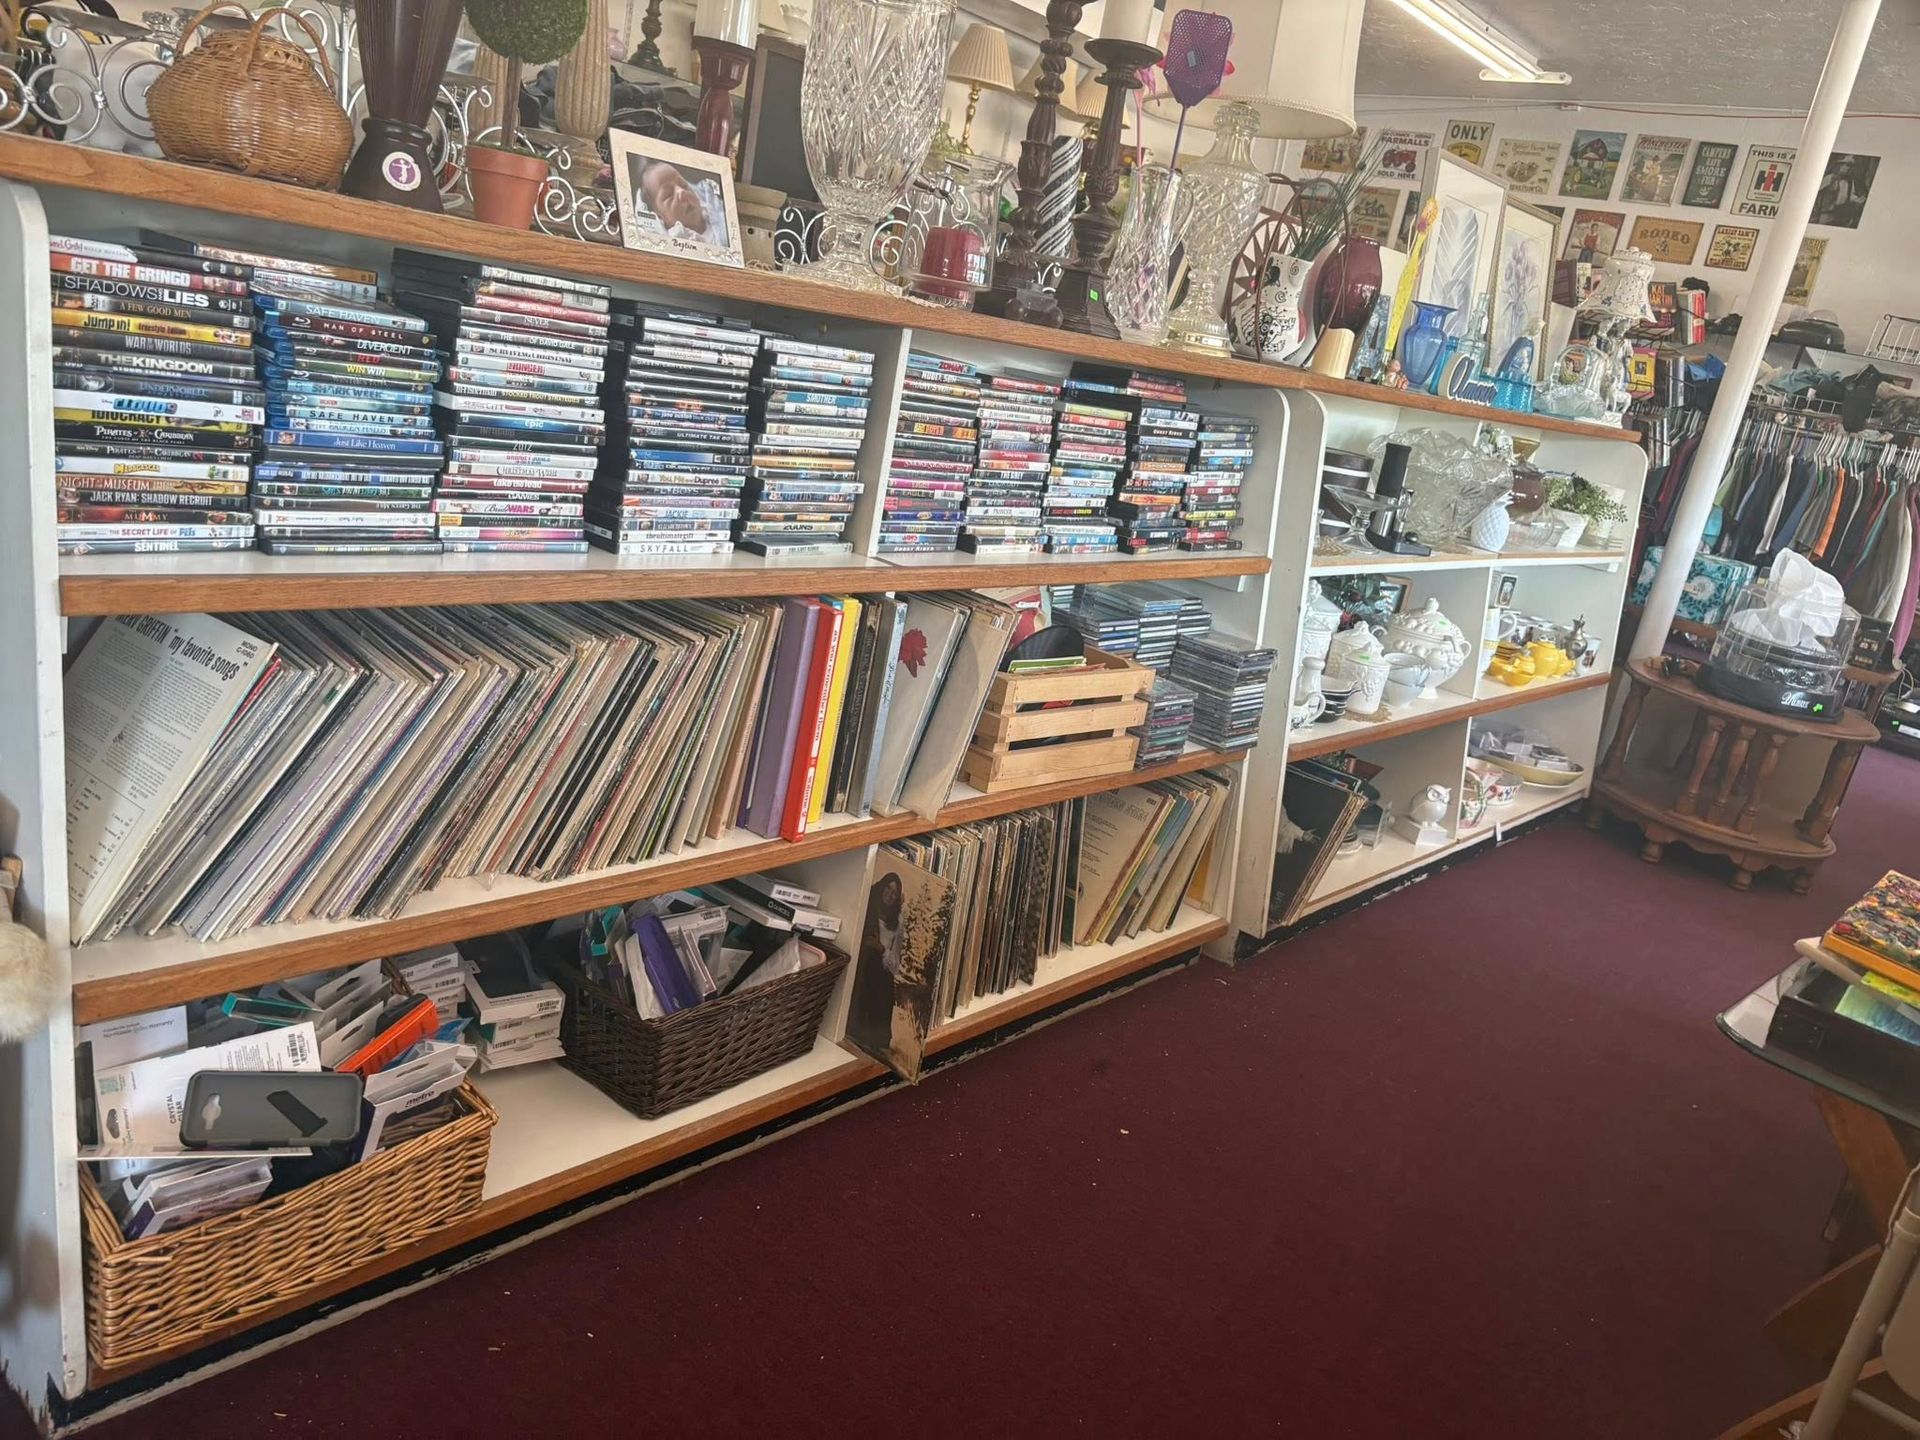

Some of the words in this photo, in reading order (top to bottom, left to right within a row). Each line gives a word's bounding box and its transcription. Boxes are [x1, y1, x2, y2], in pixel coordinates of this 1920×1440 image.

[1451, 124, 1489, 140] ONLY
[1381, 136, 1430, 147] FARMALLS
[1752, 150, 1774, 158] THIS
[1777, 151, 1787, 159] IS
[1790, 152, 1797, 160] A
[1640, 228, 1691, 244] RODEO
[672, 239, 697, 252] Baptism
[71, 257, 98, 274] GET
[104, 262, 131, 278] THE
[135, 265, 191, 287] GRINGO
[65, 275, 158, 300] SHADOWS
[163, 289, 209, 307] LIES
[127, 303, 144, 313] FEW
[147, 305, 171, 316] GOOD
[173, 307, 191, 318] MEN
[306, 305, 335, 318] SAFE
[338, 310, 381, 324] HAVEN
[84, 315, 115, 331] Jump
[116, 319, 131, 331] in!
[323, 323, 344, 331] MAN
[371, 329, 404, 340] STEEL
[125, 335, 145, 349] WAR
[154, 338, 191, 354] WORLDS
[357, 340, 413, 355] DIVERGENT
[132, 356, 213, 374] KINGDOM
[357, 354, 381, 363] RED
[345, 365, 367, 375] WIN
[367, 367, 386, 377] WIN
[312, 384, 351, 396] SHARK
[352, 387, 383, 399] WEEK
[91, 410, 161, 424] IDIOCRACY
[310, 410, 343, 420] SAFE
[353, 413, 395, 423] HAVEN
[94, 425, 132, 437] PIRATES
[154, 429, 194, 441] CARIBBEAN
[107, 446, 136, 455] PIRATES
[334, 437, 349, 448] Just
[350, 439, 367, 449] Like
[368, 440, 396, 450] Heaven
[60, 477, 95, 489] NIGHT
[104, 479, 150, 491] MUSEUM
[694, 476, 719, 485] Dupree
[90, 491, 113, 502] JACK
[115, 491, 139, 503] RYAN:
[141, 492, 177, 504] SHADOW
[179, 493, 213, 506] RECRUIT
[654, 487, 699, 496] FLYBOYS
[125, 511, 168, 521] MUMMY
[508, 505, 535, 513] WARS
[121, 528, 151, 536] SECRET
[152, 528, 169, 536] LIFE
[134, 541, 179, 552] SENTINEL
[640, 545, 689, 553] SKYFALL
[135, 615, 172, 644] GRIFFIN
[181, 637, 215, 667] favorite
[241, 640, 258, 652] MONO
[820, 665, 832, 713] remember
[815, 717, 824, 741] them
[406, 1090, 436, 1108] metro
[167, 1094, 177, 1125] CRYSTAL
